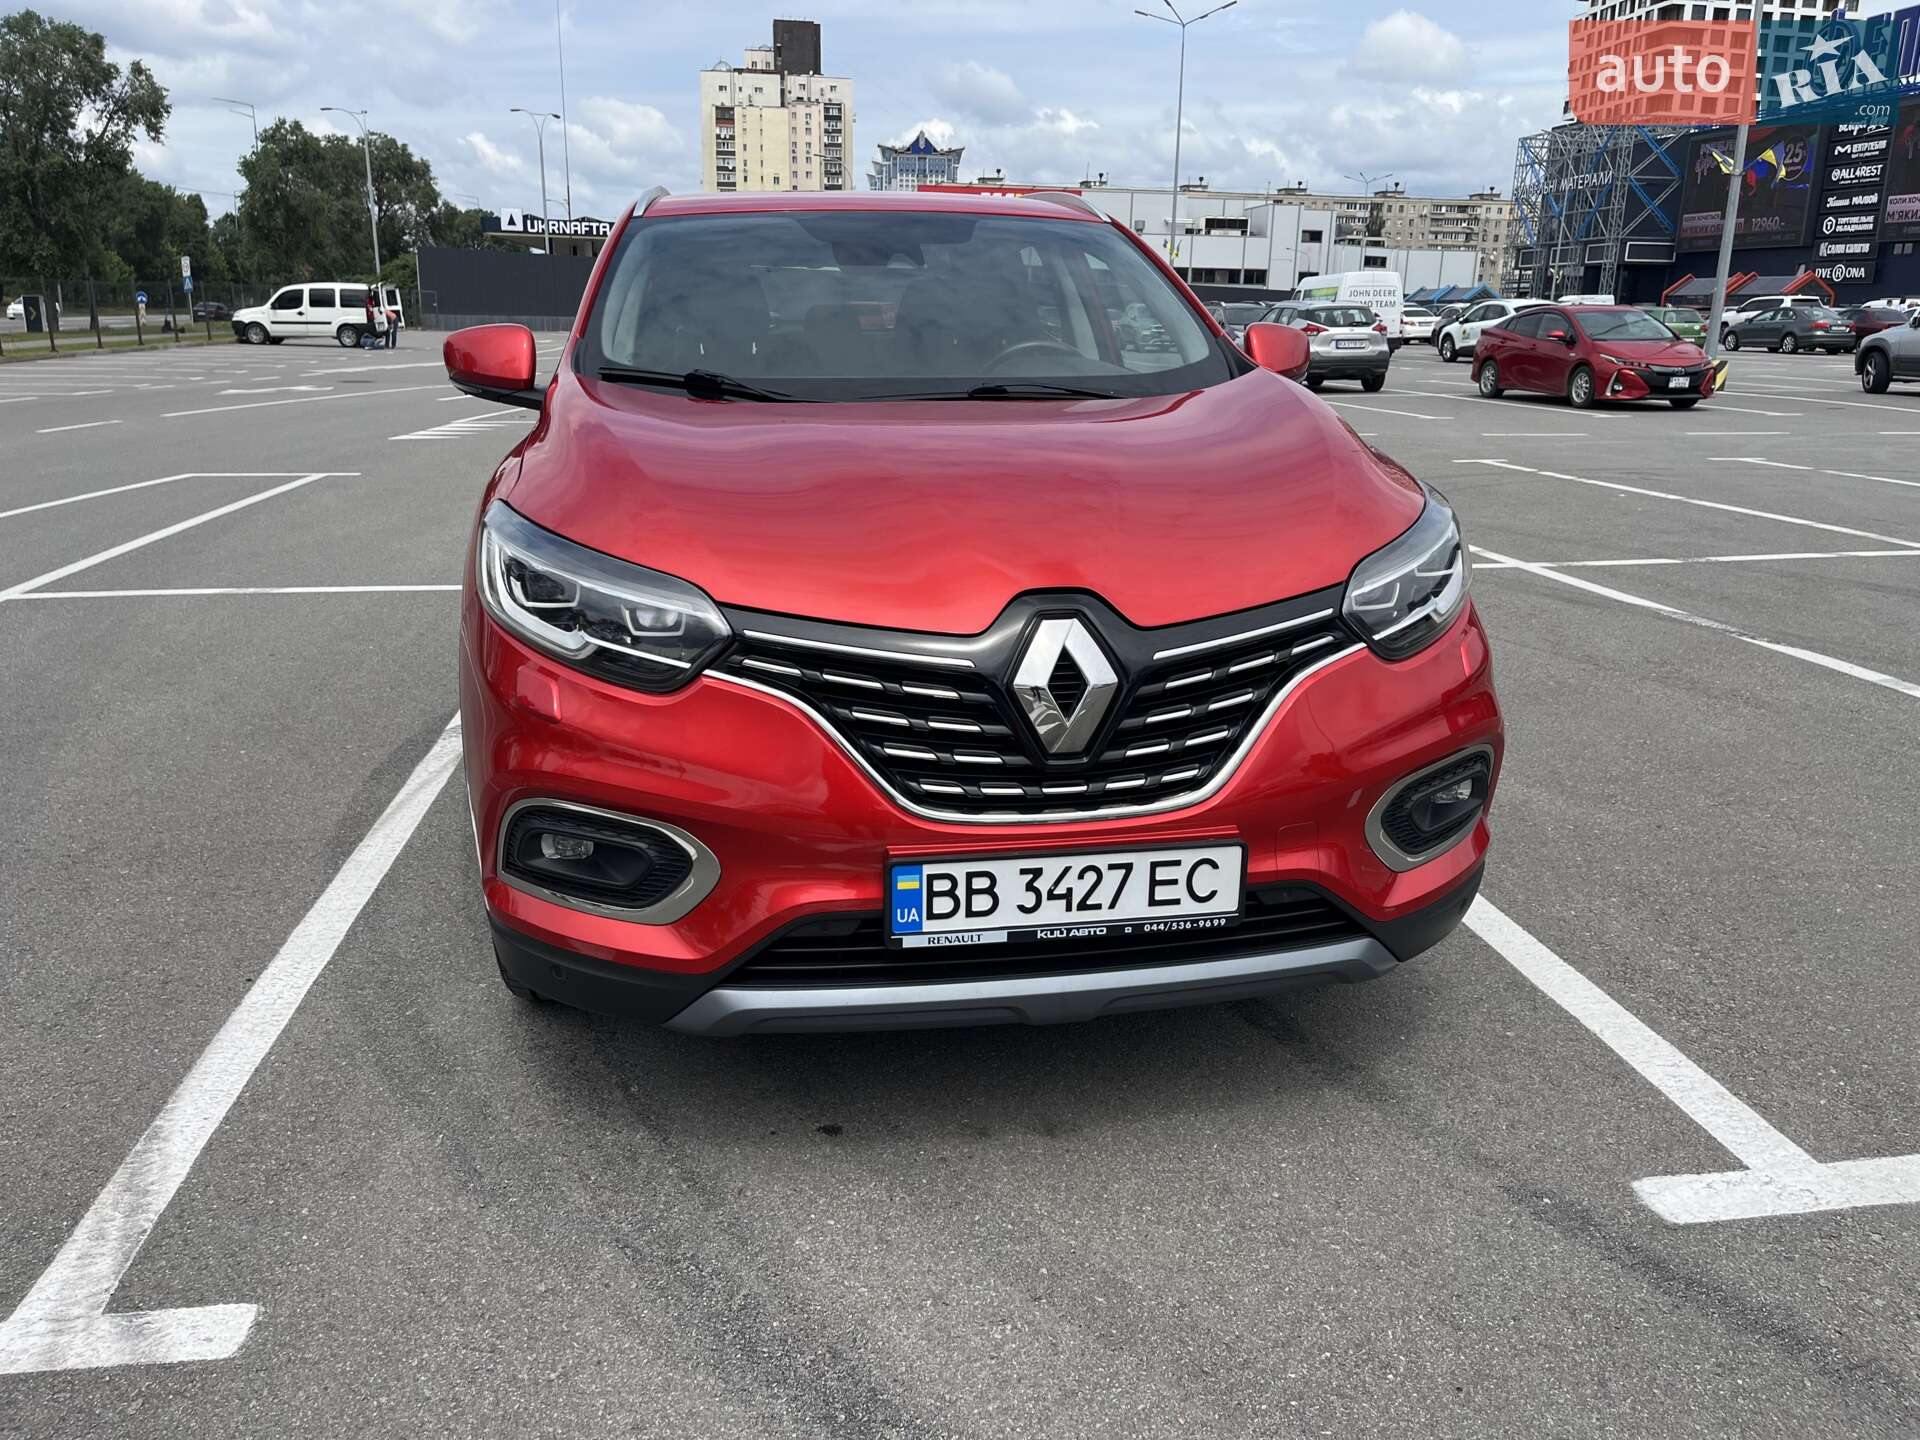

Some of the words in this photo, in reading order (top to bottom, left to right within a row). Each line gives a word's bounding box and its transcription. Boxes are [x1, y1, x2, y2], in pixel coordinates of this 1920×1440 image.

[1559, 169, 1613, 191] МАТЕРІАЛИ
[526, 219, 611, 235] UKRNAFTA
[1348, 289, 1371, 298] JOHN
[1373, 289, 1397, 297] DEERE
[1375, 300, 1396, 308] TEAM
[925, 870, 999, 920] BB
[1016, 862, 1134, 914] 3427
[1147, 857, 1220, 907] EC
[896, 907, 920, 923] UA
[1144, 918, 1226, 932] 044/536-9699
[927, 933, 984, 945] RENAULT
